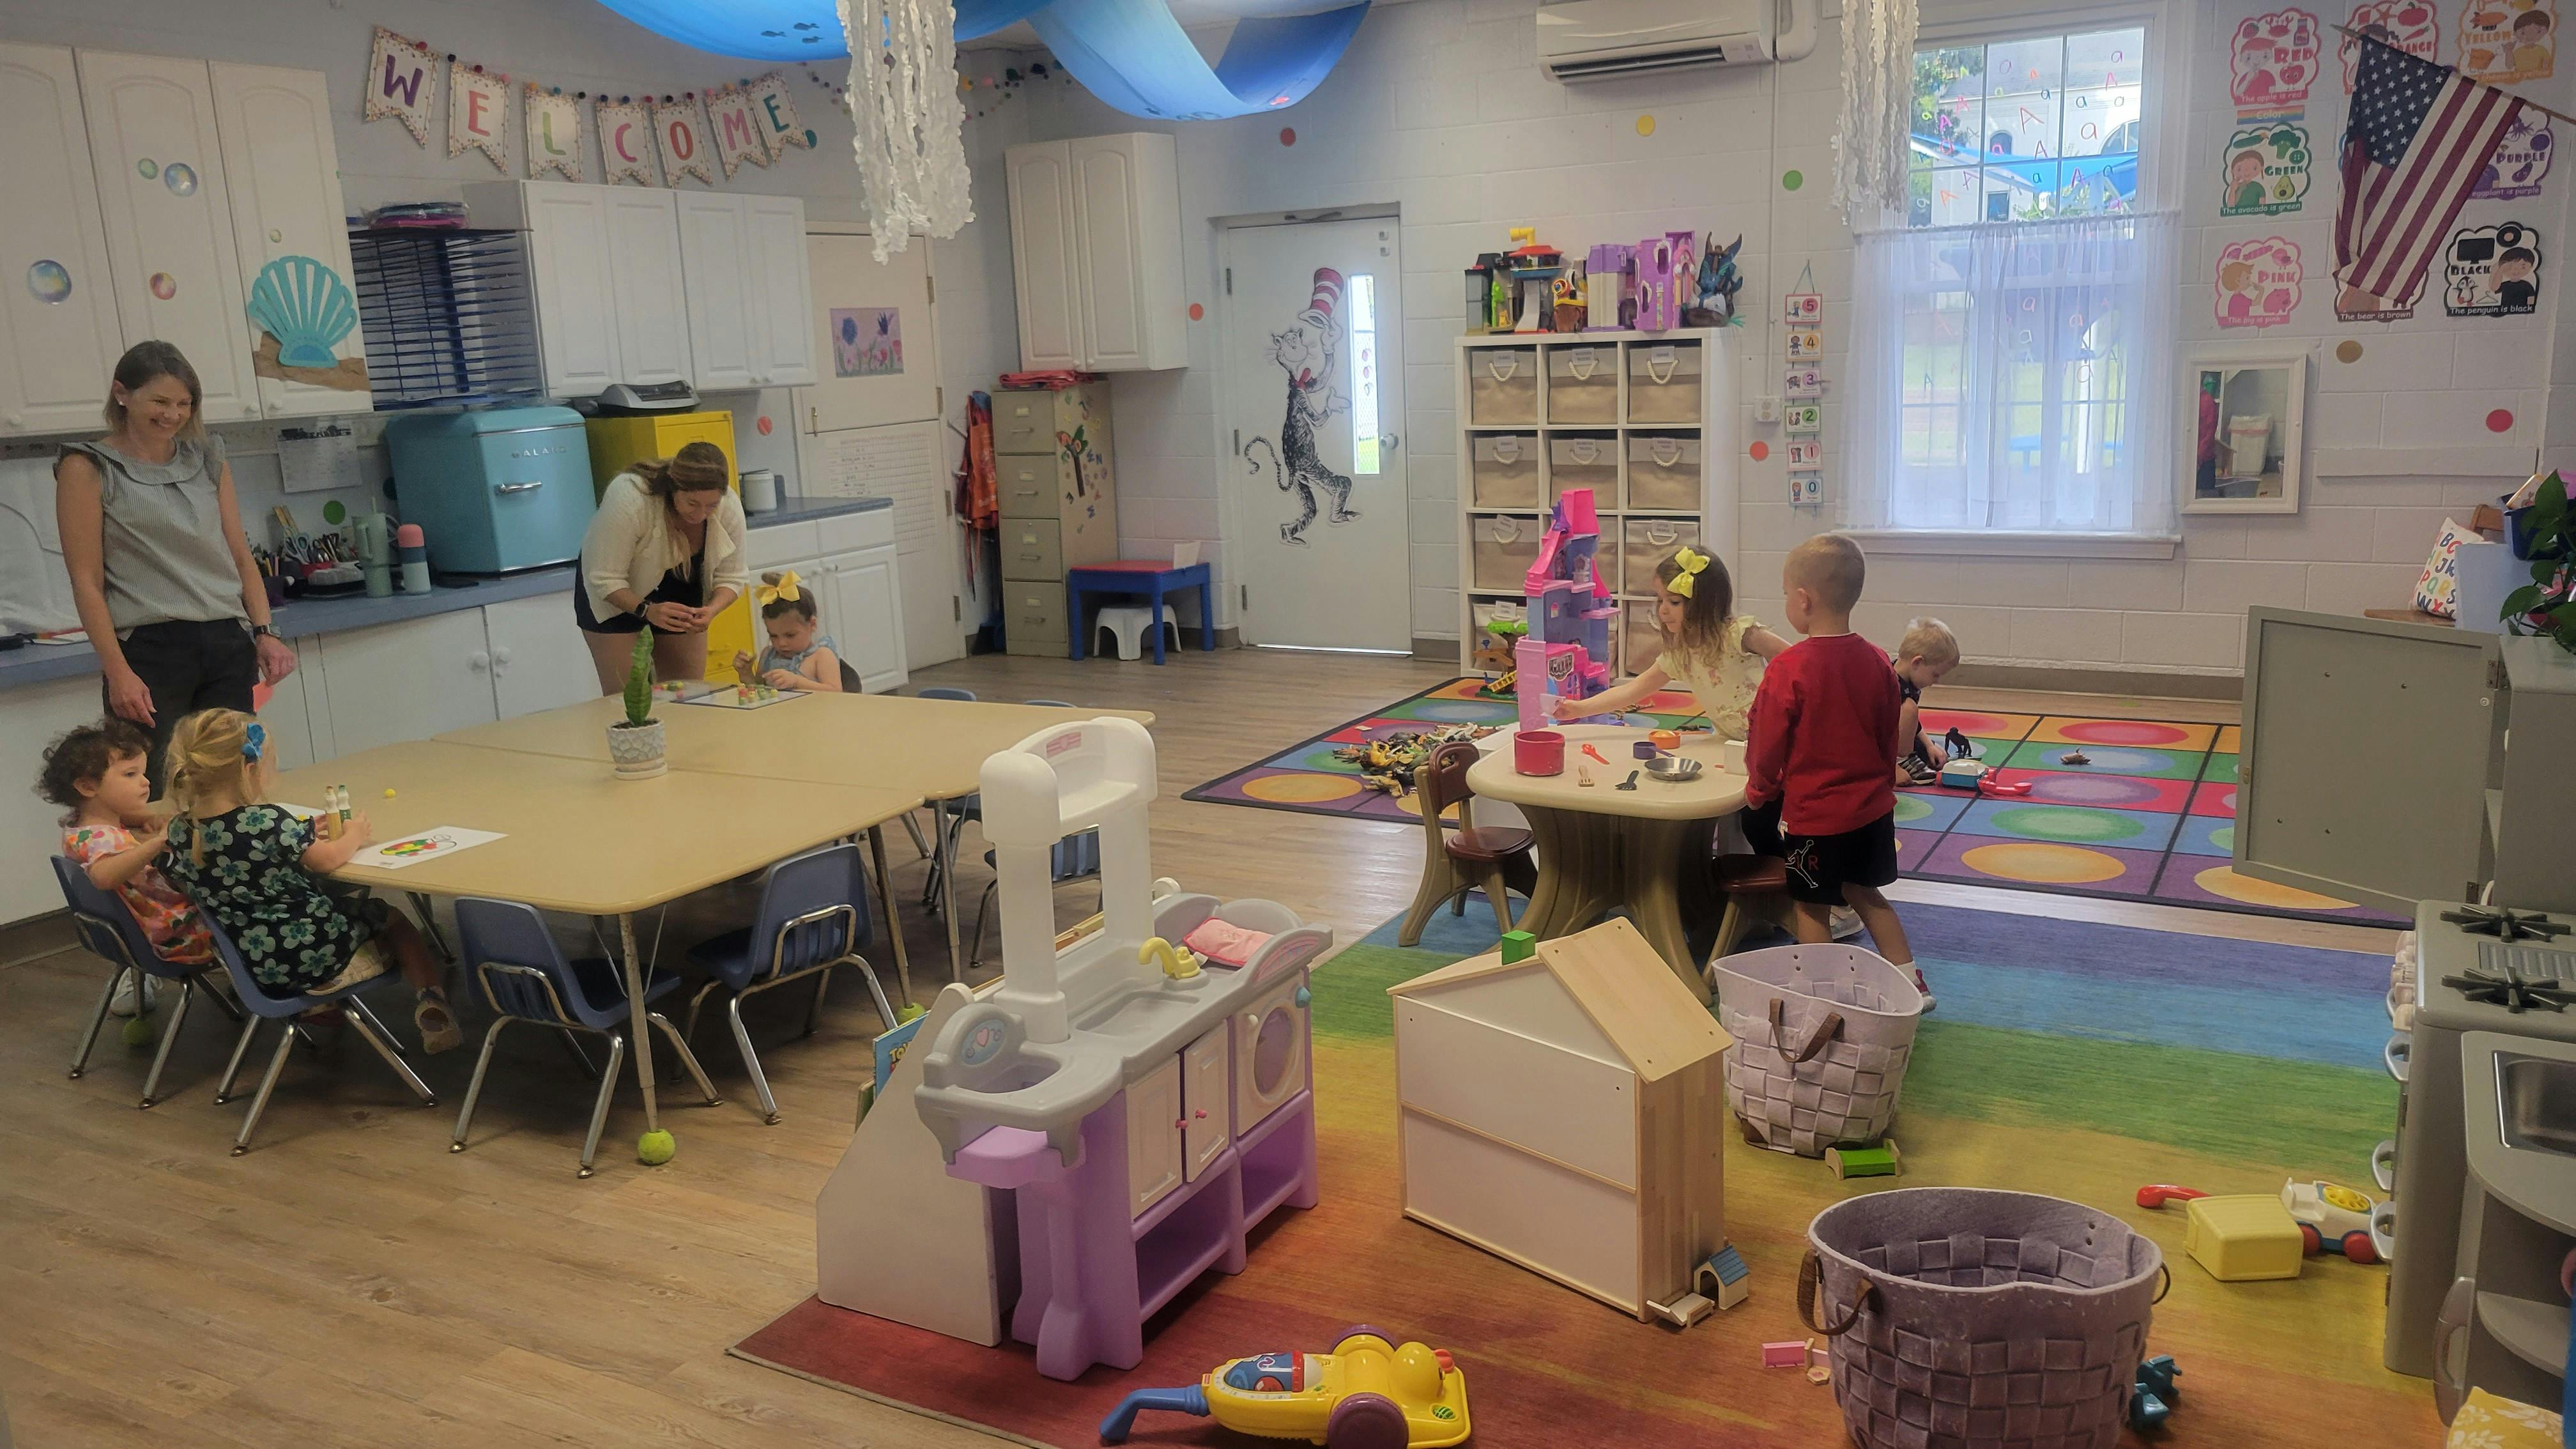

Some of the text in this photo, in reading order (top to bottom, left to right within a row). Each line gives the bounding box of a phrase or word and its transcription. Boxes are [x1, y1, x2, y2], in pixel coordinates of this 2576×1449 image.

[2274, 47, 2313, 64] RED
[2257, 93, 2278, 103] apple
[383, 54, 790, 162] WELCOME
[2256, 109, 2282, 119] Color
[2497, 152, 2545, 164] PURPLE
[2264, 165, 2303, 176] GREEN
[2472, 189, 2504, 197] eggplant
[2515, 187, 2540, 197] purple
[2238, 204, 2268, 214] avocado
[2278, 203, 2301, 212] green
[2451, 265, 2491, 275] BLACK
[2258, 270, 2296, 284] PINK
[1807, 300, 1814, 311] 5
[2467, 307, 2498, 316] penguin
[2243, 316, 2255, 324] pig
[2265, 316, 2280, 324] pink
[1807, 337, 1815, 348] 4
[1807, 374, 1814, 385] 3
[1805, 411, 1814, 422] 2
[1809, 482, 1816, 493] 0
